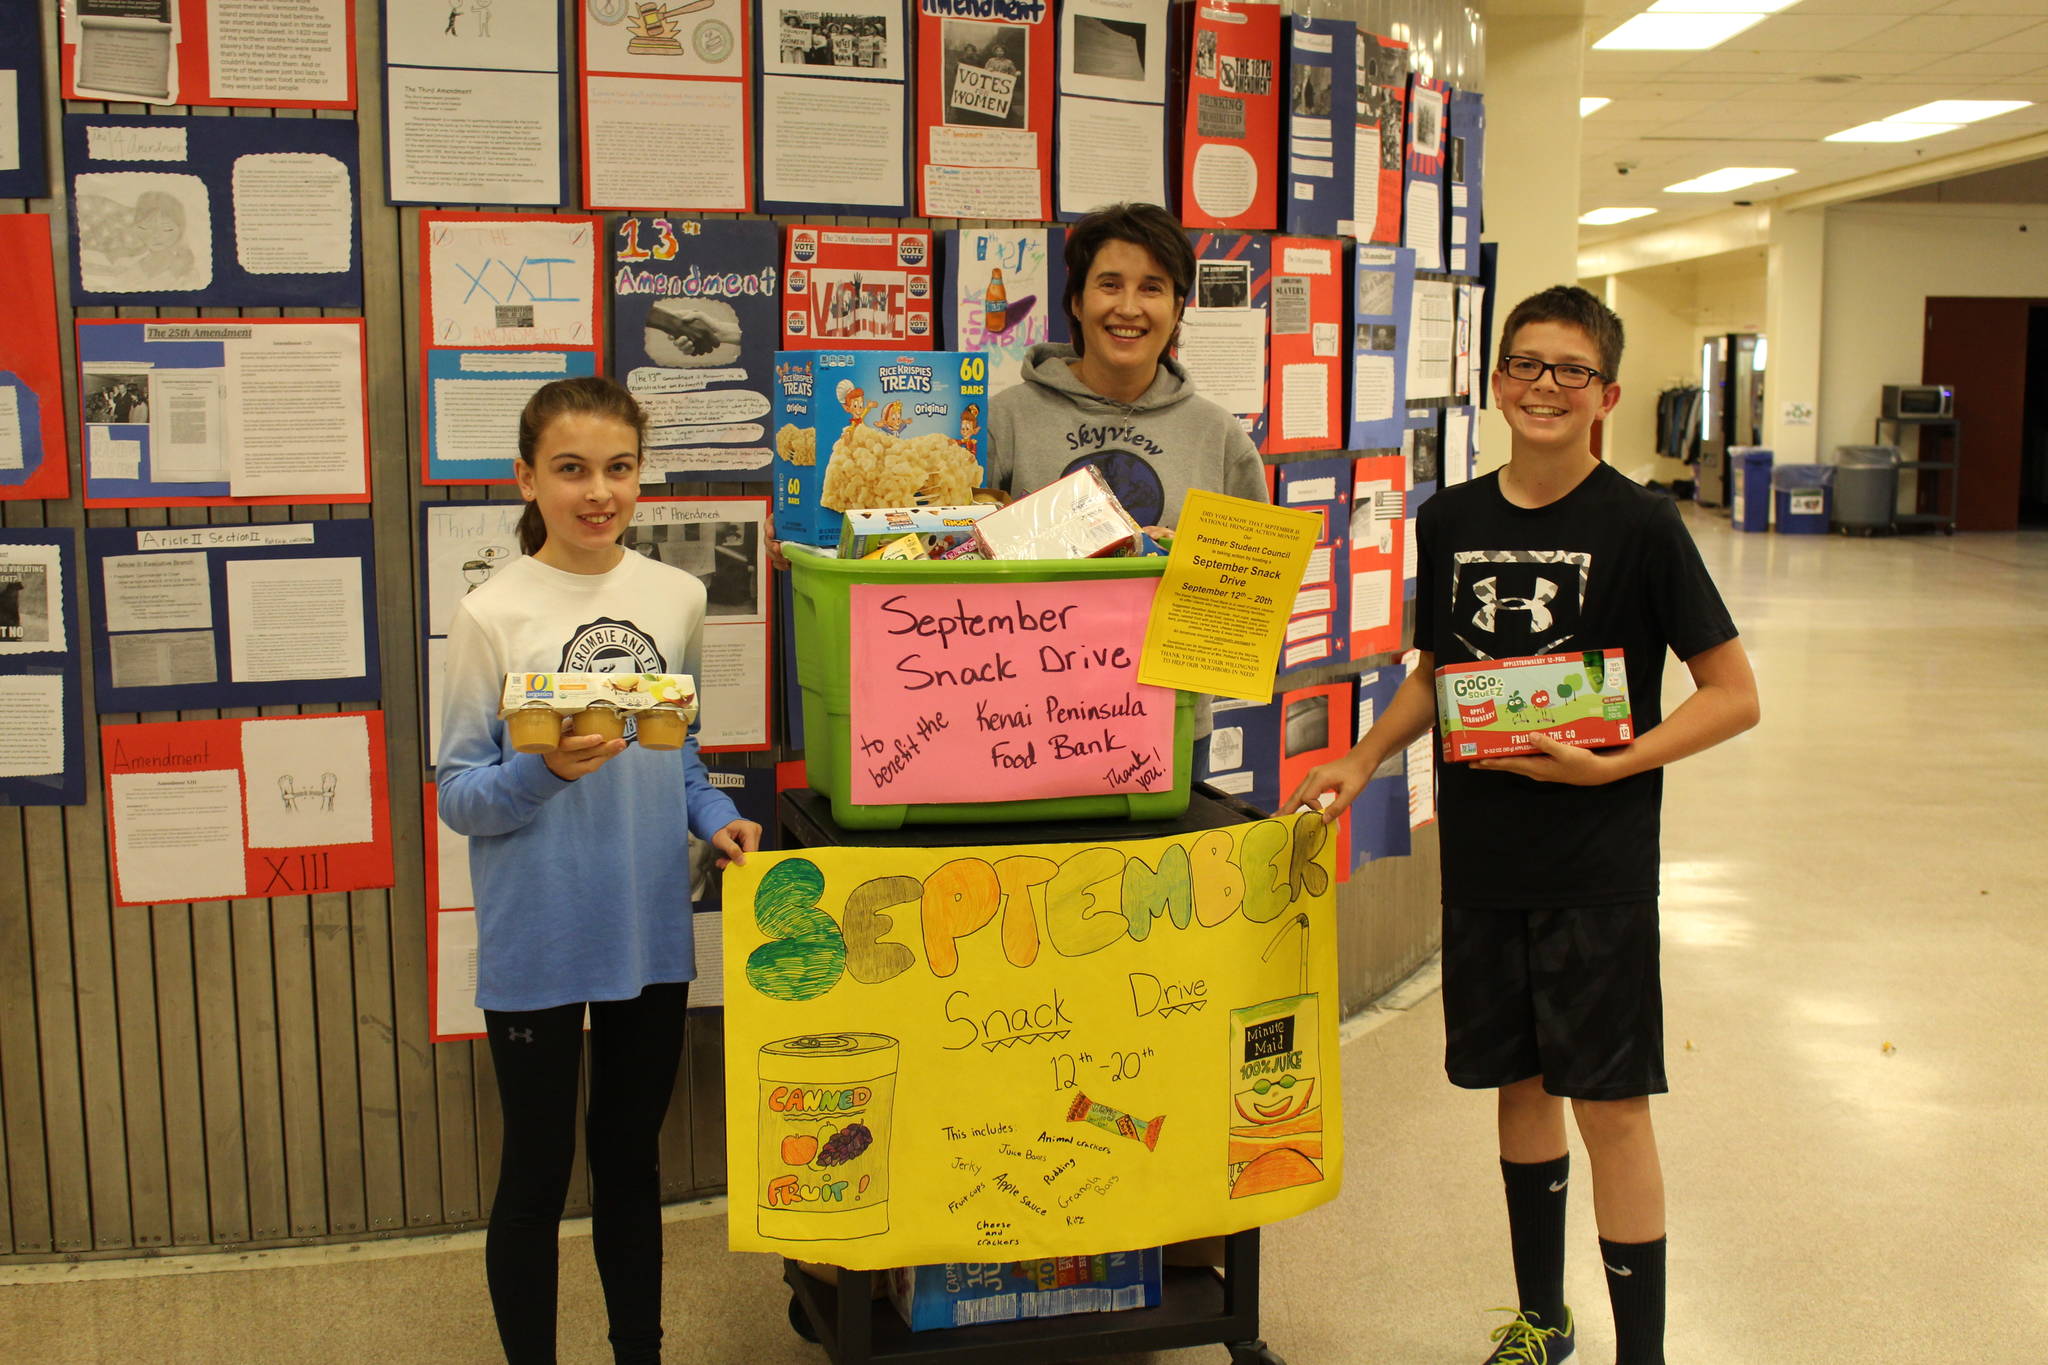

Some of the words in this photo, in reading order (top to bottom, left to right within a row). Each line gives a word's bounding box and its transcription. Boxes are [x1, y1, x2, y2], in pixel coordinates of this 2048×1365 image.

[1235, 58, 1249, 76] THE
[1251, 59, 1272, 77] 18TH
[960, 69, 1011, 94] VOTES
[954, 90, 1008, 113] WOMEN
[455, 256, 580, 304] XXI
[616, 264, 776, 296] Amendment
[812, 282, 904, 337] VOTE
[148, 329, 165, 337] The
[168, 328, 190, 337] 25th
[193, 329, 252, 337] Amendment
[793, 375, 813, 384] KRISPIES
[880, 367, 897, 376] RICE
[898, 365, 932, 376] KRISPIES
[960, 358, 984, 381] 60
[783, 383, 812, 396] TREATS
[881, 376, 931, 393] TREATS
[961, 386, 984, 395] BARS
[787, 404, 807, 415] Original
[915, 403, 947, 416] Original
[1067, 424, 1163, 455] Skyview
[788, 479, 800, 495] 60
[1200, 517, 1228, 527] NATIONAL
[1229, 524, 1253, 533] HUNGER
[1265, 523, 1294, 533] SEPTEMBER
[1197, 534, 1228, 546] Panther
[1230, 541, 1260, 553] Student
[1262, 548, 1291, 558] Council
[1193, 555, 1248, 574] September
[1250, 566, 1281, 579] Snack
[1220, 575, 1246, 587] Drive
[1182, 582, 1228, 598] September
[1231, 591, 1246, 599] 12th
[1254, 595, 1272, 605] 20th
[9, 627, 23, 638] NO
[880, 595, 1078, 648] September
[571, 630, 616, 671] CROMBIE
[621, 633, 645, 655] AND
[1161, 650, 1181, 659] THANK
[1226, 662, 1259, 671] WILLINGNESS
[896, 654, 1017, 690] Snack
[1039, 645, 1131, 673] Drive
[1201, 664, 1230, 673] NEIGHBORS
[1469, 688, 1503, 698] SQUEEZ
[976, 699, 1032, 731] Kenai
[1047, 691, 1147, 723] Peninsula
[1462, 712, 1495, 723] STRAWBERRY
[1512, 734, 1529, 744] FRUI
[1548, 731, 1562, 741] THE
[1566, 730, 1576, 739] GO
[1622, 727, 1629, 738] 12
[114, 739, 211, 770] Amendment
[861, 735, 884, 757] to
[869, 736, 920, 788] benefit
[917, 711, 949, 742] the
[991, 741, 1036, 769] Food
[1048, 729, 1127, 760] Bank
[1103, 750, 1150, 788] Thank
[1136, 747, 1167, 791] you!
[264, 853, 329, 893] XIII
[745, 811, 1330, 1001] SEPTEMBER
[943, 989, 1072, 1049] Snack
[1129, 973, 1207, 1017] Drive
[1248, 1021, 1284, 1042] Minute
[1255, 1035, 1283, 1055] Maid
[1051, 1052, 1092, 1091] 12th
[1240, 1060, 1271, 1080] 100%
[769, 1086, 872, 1112] CANNED
[942, 1126, 966, 1141] This
[1037, 1131, 1073, 1144] Animal
[1076, 1140, 1111, 1154] crackers
[999, 1144, 1021, 1156] Juice
[952, 1157, 982, 1176] Jerky
[1044, 1158, 1076, 1185] Pudding
[993, 1173, 1019, 1196] Apple
[1020, 1196, 1047, 1216] Sauce
[1058, 1176, 1101, 1209] Granola
[1094, 1175, 1119, 1196] Bars
[948, 1196, 968, 1214] Fruit
[970, 1182, 985, 1197] cups
[977, 1221, 1011, 1230] Cheese
[1041, 1263, 1056, 1286] 40
